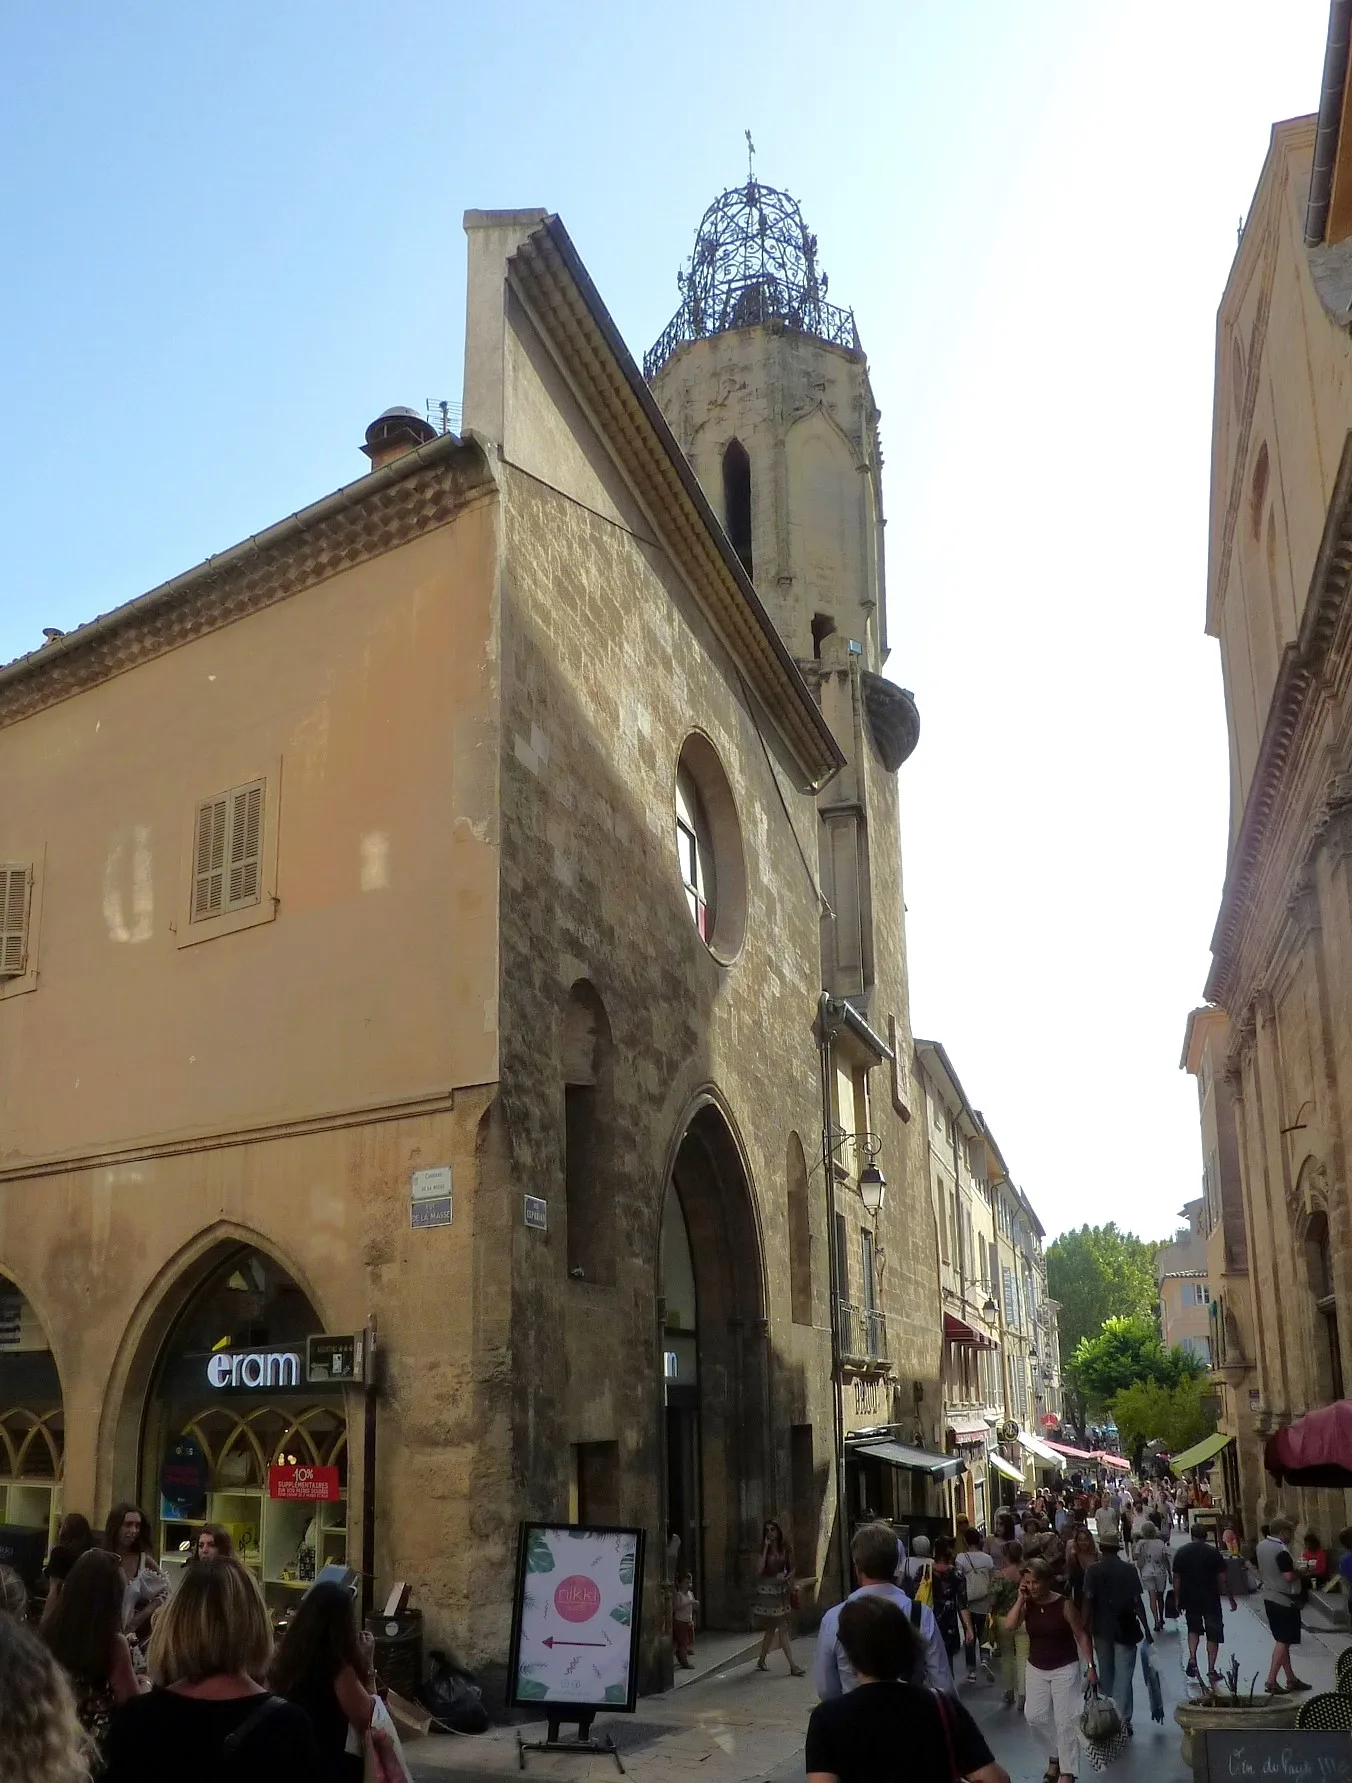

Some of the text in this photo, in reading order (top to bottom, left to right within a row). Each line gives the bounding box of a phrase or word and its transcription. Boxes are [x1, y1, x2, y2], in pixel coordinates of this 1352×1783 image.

[420, 1213, 429, 1221] LA
[430, 1210, 450, 1220] MASSE
[293, 1468, 313, 1482] -10%
